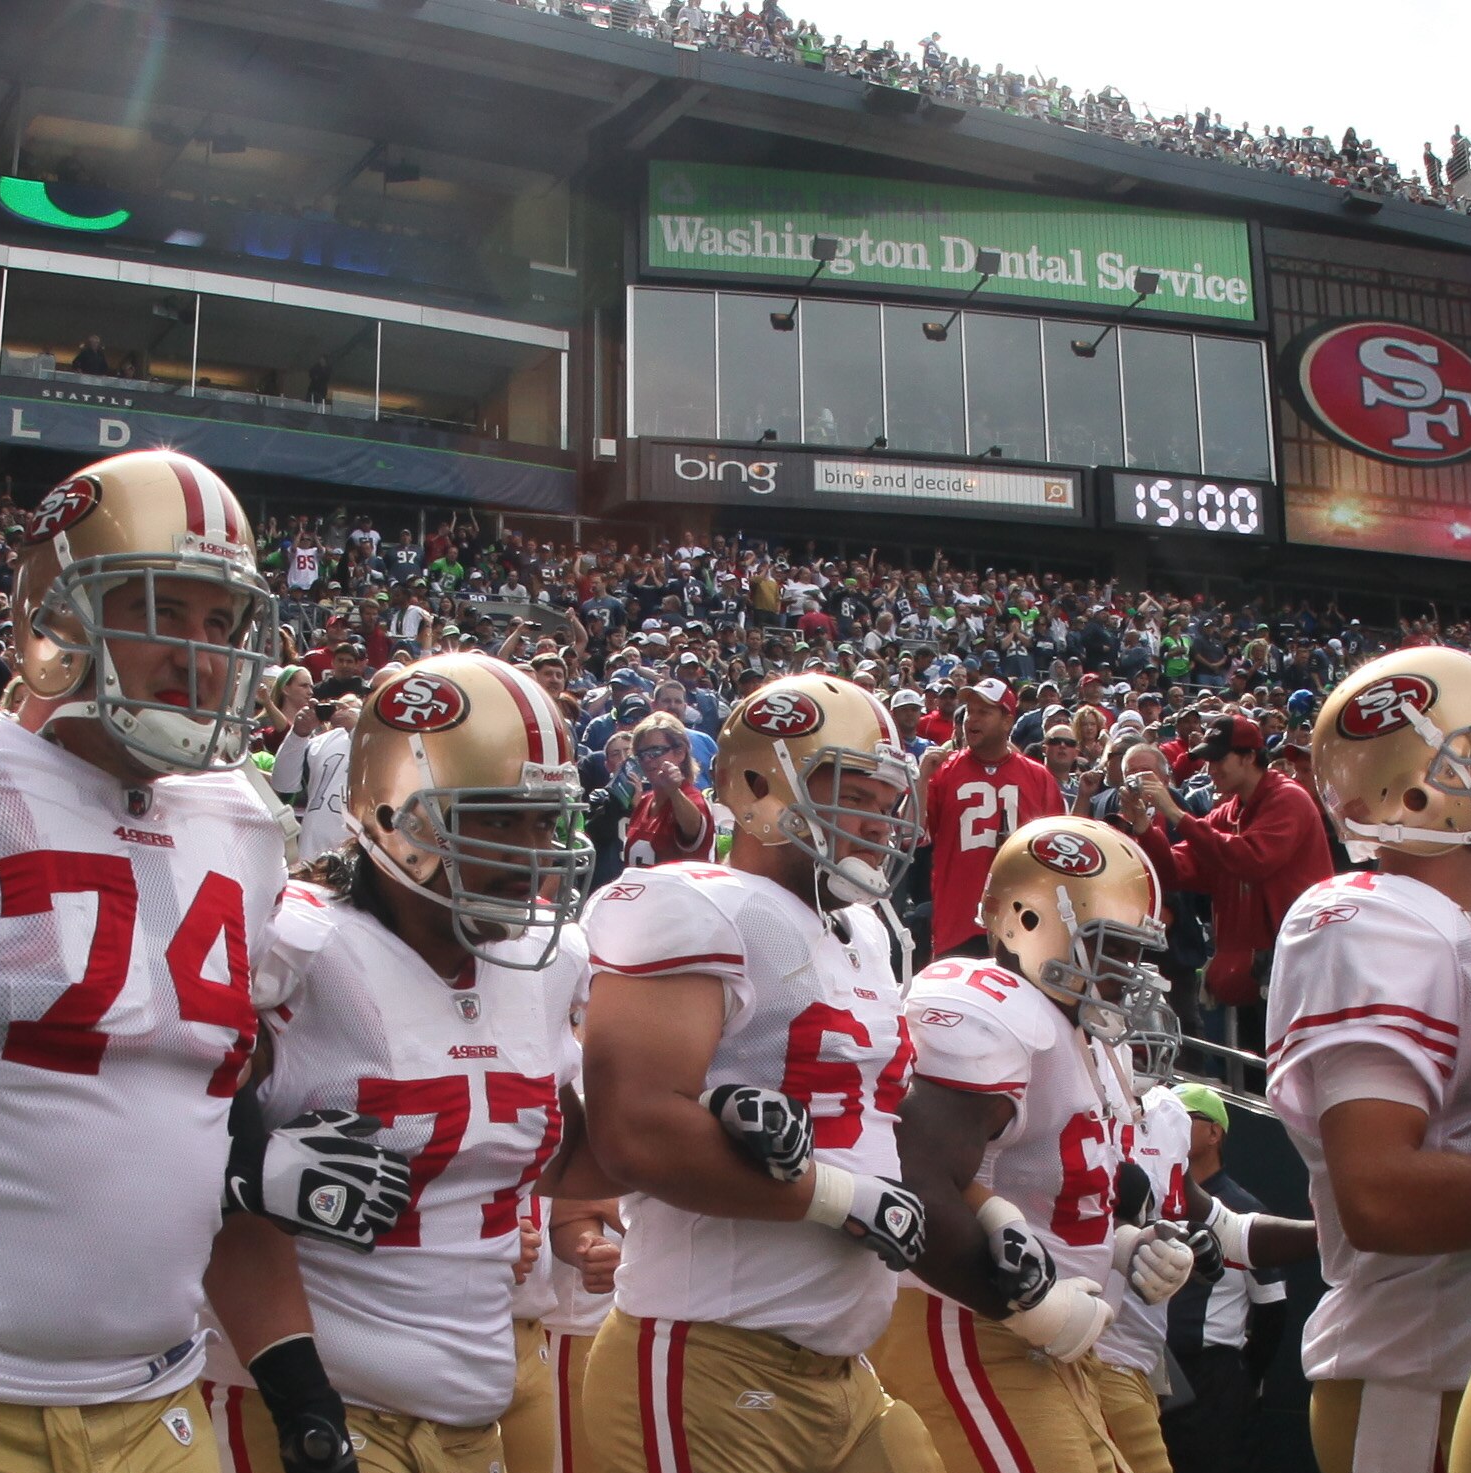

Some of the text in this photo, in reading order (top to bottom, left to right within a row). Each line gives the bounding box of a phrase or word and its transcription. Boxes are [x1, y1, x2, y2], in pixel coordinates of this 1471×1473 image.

[658, 215, 930, 275] Washington
[941, 235, 1085, 288] Dntal
[42, 389, 135, 407] SEATTLE
[674, 453, 779, 493] bing
[823, 467, 974, 495] bing and decide
[1134, 478, 1258, 535] 15:00
[297, 555, 316, 570] 85
[397, 551, 416, 564] 97
[393, 675, 449, 726] SF
[753, 692, 807, 731] SF
[957, 781, 1020, 852] 21
[113, 826, 176, 848] 49ERS
[447, 1045, 498, 1059] 49ERS
[356, 1071, 563, 1248] 77
[1050, 1111, 1119, 1246] 6
